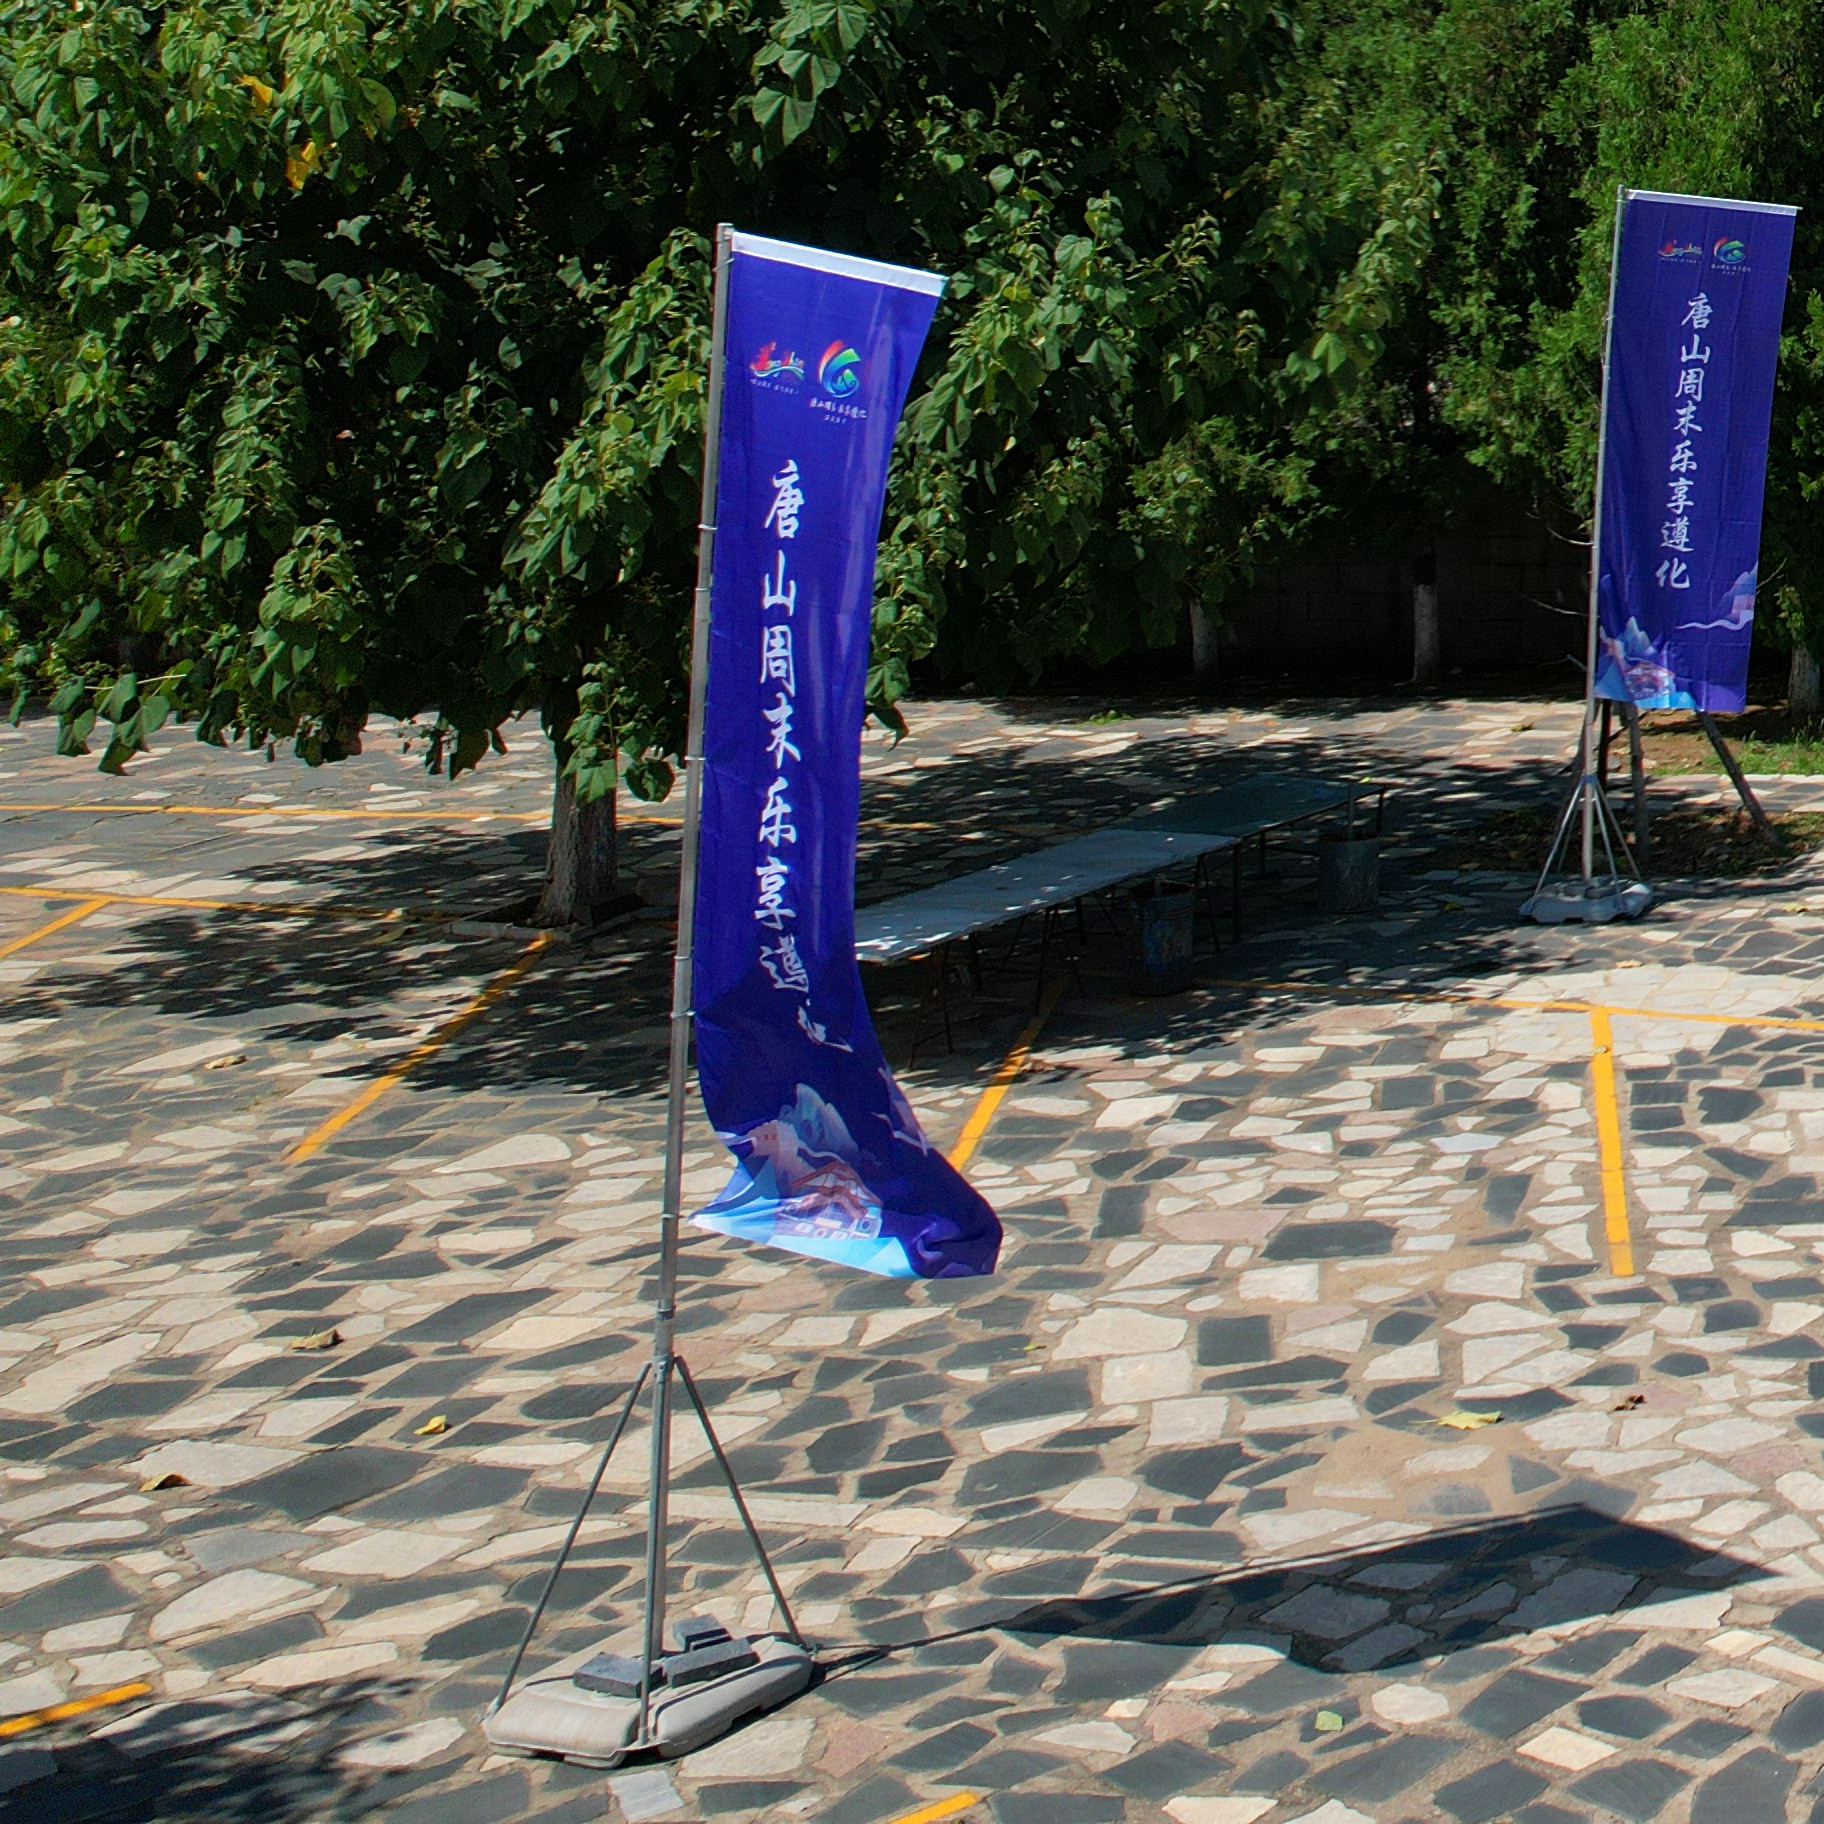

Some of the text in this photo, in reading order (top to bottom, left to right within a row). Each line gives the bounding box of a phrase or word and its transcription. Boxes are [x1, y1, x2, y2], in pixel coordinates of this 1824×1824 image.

[1655, 292, 1714, 589] 唐山周末乐享遵化
